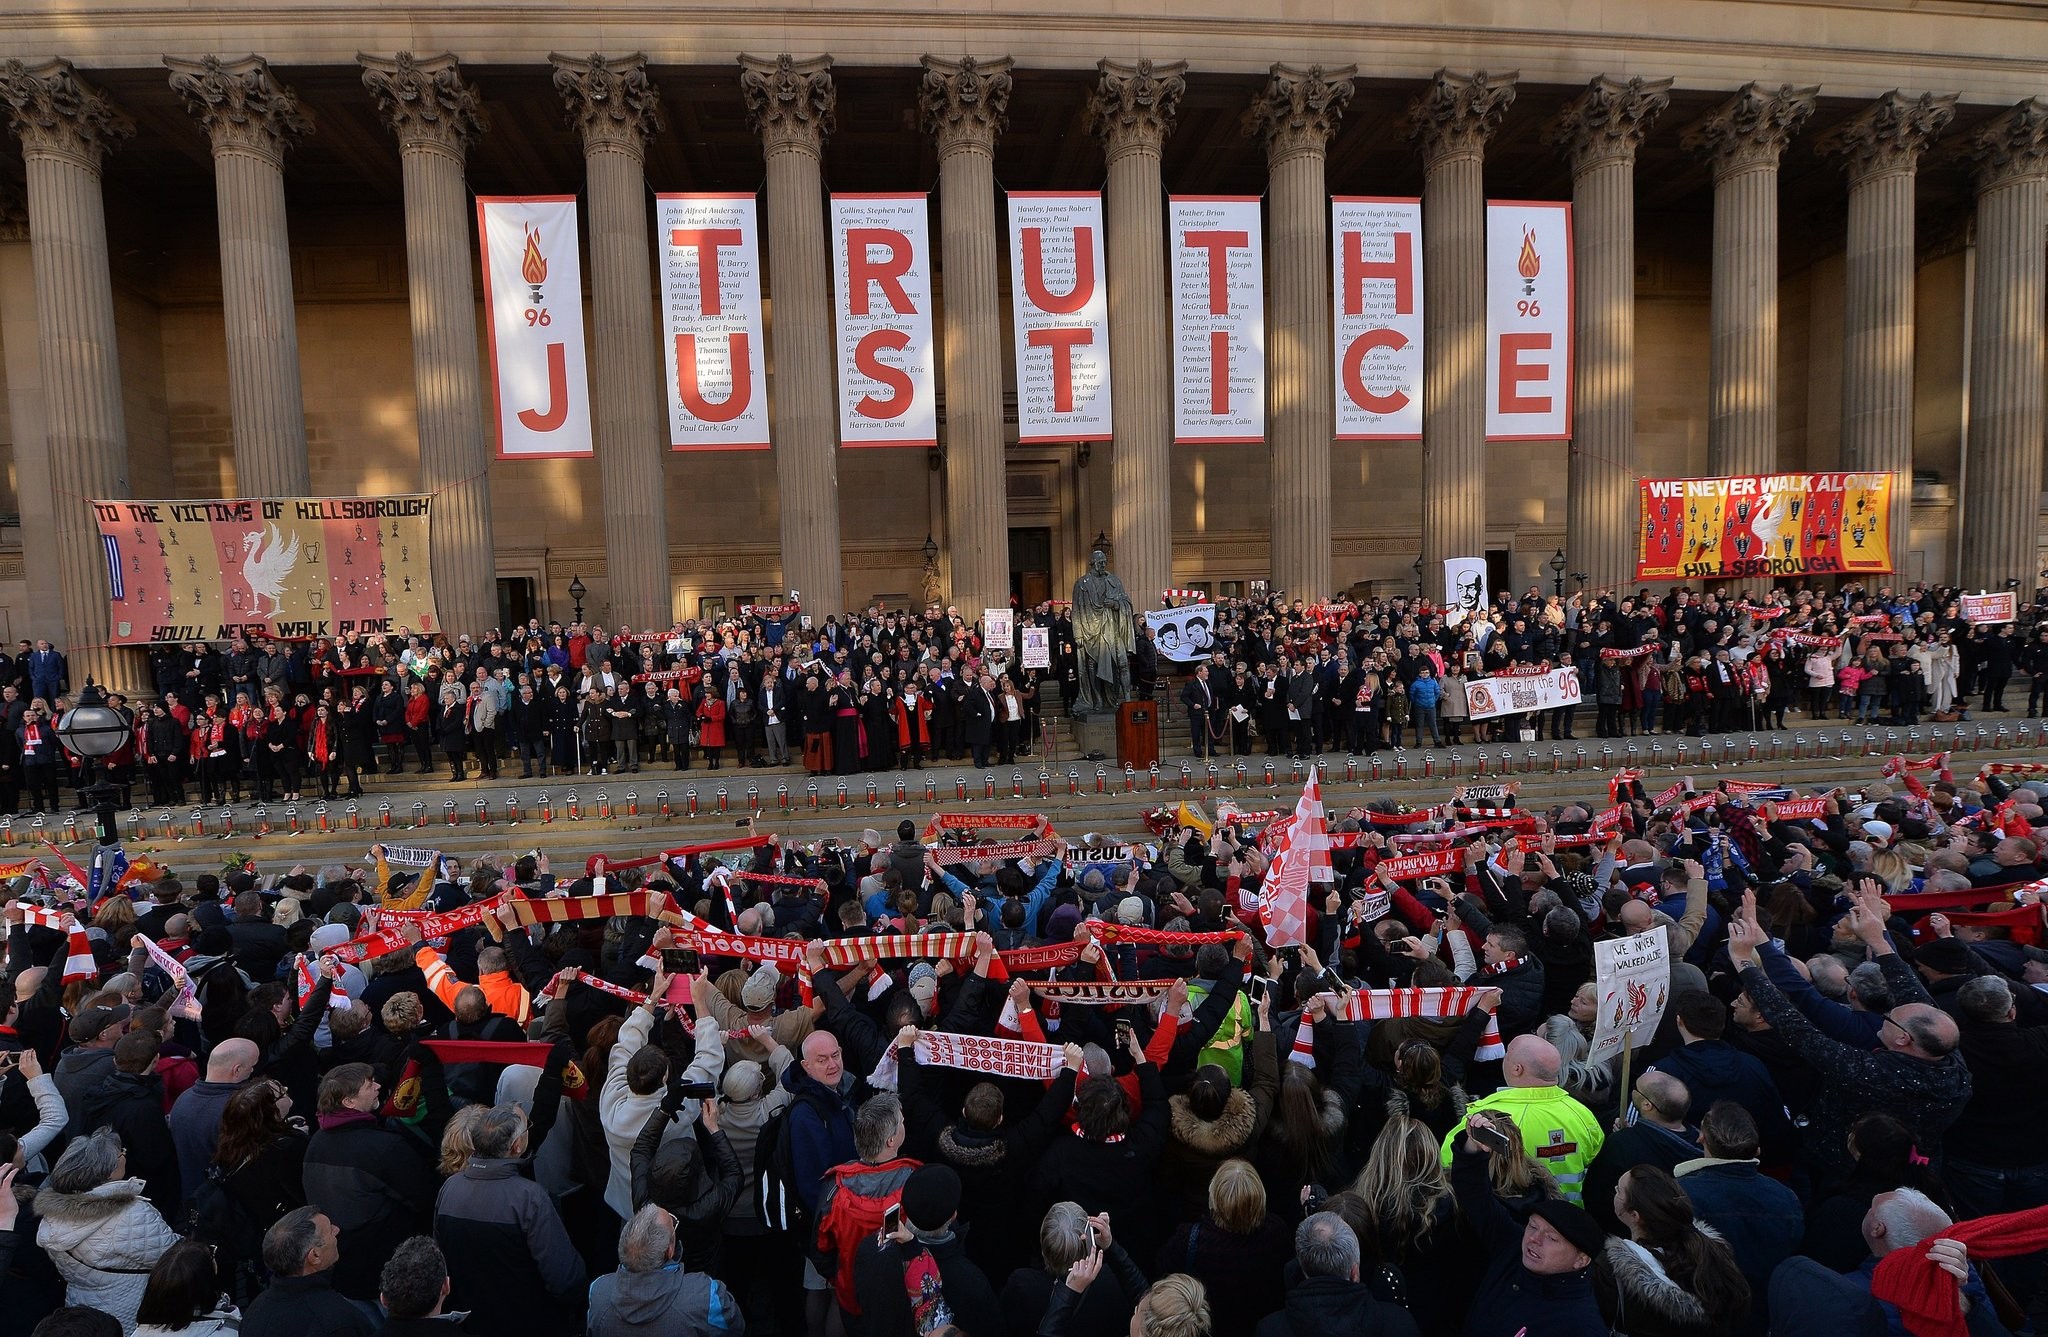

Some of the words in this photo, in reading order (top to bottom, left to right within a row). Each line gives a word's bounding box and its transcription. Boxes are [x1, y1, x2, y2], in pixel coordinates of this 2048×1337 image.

[867, 207, 895, 215] Stephen
[709, 218, 741, 226] Ashcroft,
[866, 217, 889, 225] Tracey
[1365, 221, 1381, 229] Inger
[1179, 251, 1195, 259] John
[670, 272, 694, 280] Sidney
[726, 292, 743, 300] Tony
[1517, 300, 1541, 317] 96
[525, 308, 551, 327] 96
[672, 315, 695, 323] Brady,
[1023, 321, 1052, 329] Anthony
[1236, 345, 1248, 353] Roy
[1025, 375, 1045, 383] Jones,
[1026, 386, 1048, 394] Joynes,
[1210, 418, 1233, 426] Rogers,
[698, 424, 719, 432] Clark,
[721, 424, 738, 432] Gary
[1649, 481, 1683, 498] WE
[1688, 478, 1756, 498] NEVER
[1760, 475, 1814, 494] WALK
[1816, 473, 1886, 491] ALONE
[94, 504, 118, 521] TO
[126, 505, 160, 522] THE
[169, 502, 253, 522] VICTIMS
[261, 502, 284, 520] OF
[297, 498, 430, 520] HILLSBOROUGH
[1684, 555, 1839, 577] HILLSBOROUGH
[151, 625, 206, 640] YOU'LL
[277, 620, 329, 638] WALK
[339, 618, 394, 635] ALONE
[630, 633, 661, 641] JUSTICE
[1792, 633, 1820, 644] JUSTICE
[1512, 666, 1541, 675] JUSTICE
[648, 671, 681, 680] JUSTICE
[1524, 677, 1536, 691] for
[1539, 675, 1554, 689] the
[1558, 672, 1579, 700] 96
[1388, 854, 1439, 871] LIVERPOOL
[423, 922, 455, 938] NEVER
[461, 914, 481, 925] WAL
[1614, 944, 1629, 956] WE
[1008, 945, 1080, 966] REDS
[1616, 956, 1645, 970] WALKED
